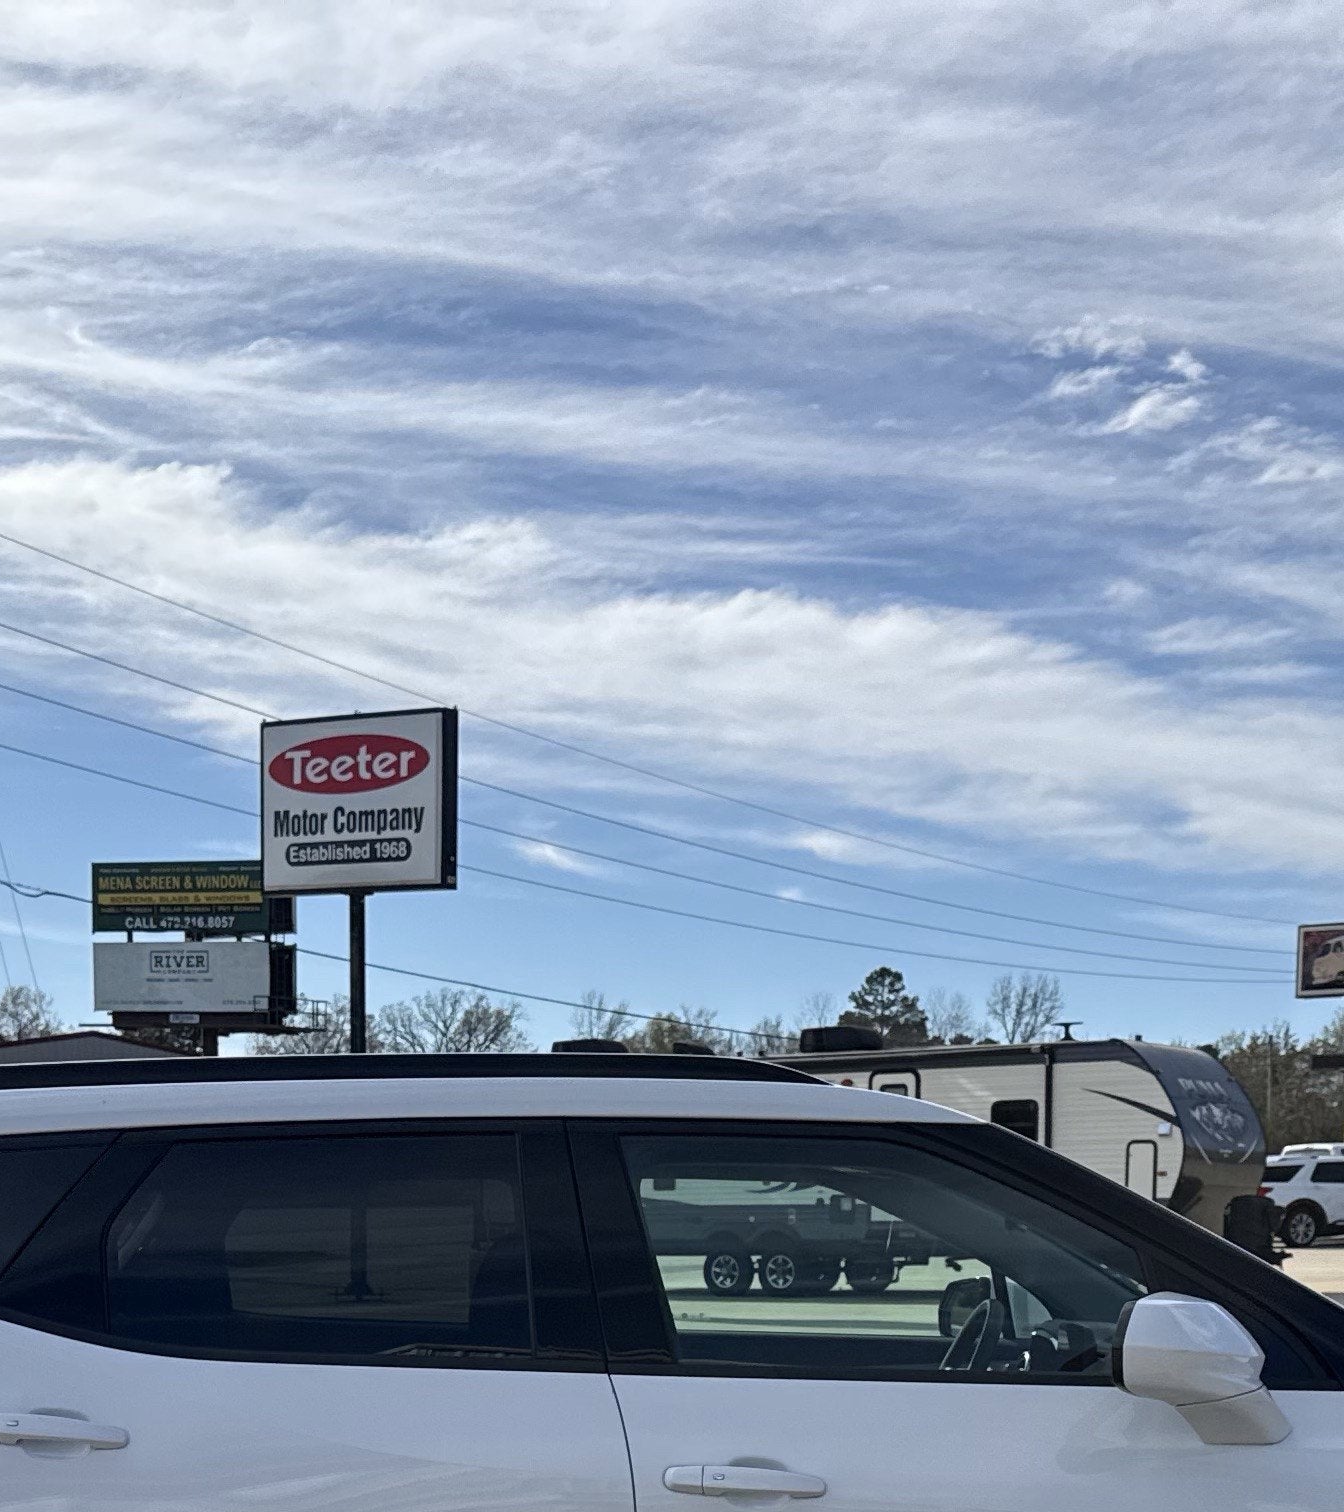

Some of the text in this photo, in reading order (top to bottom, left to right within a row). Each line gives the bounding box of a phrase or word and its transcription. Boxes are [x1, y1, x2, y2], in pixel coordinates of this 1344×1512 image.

[284, 744, 416, 785] Teeter
[273, 805, 425, 838] Motor Company
[289, 841, 407, 863] Established 1968
[98, 876, 133, 890] MENA
[136, 875, 182, 890] SCREEN
[184, 875, 193, 889] &
[196, 874, 250, 889] WINDOW
[125, 917, 158, 929] CALL
[153, 955, 206, 968] RIVER
